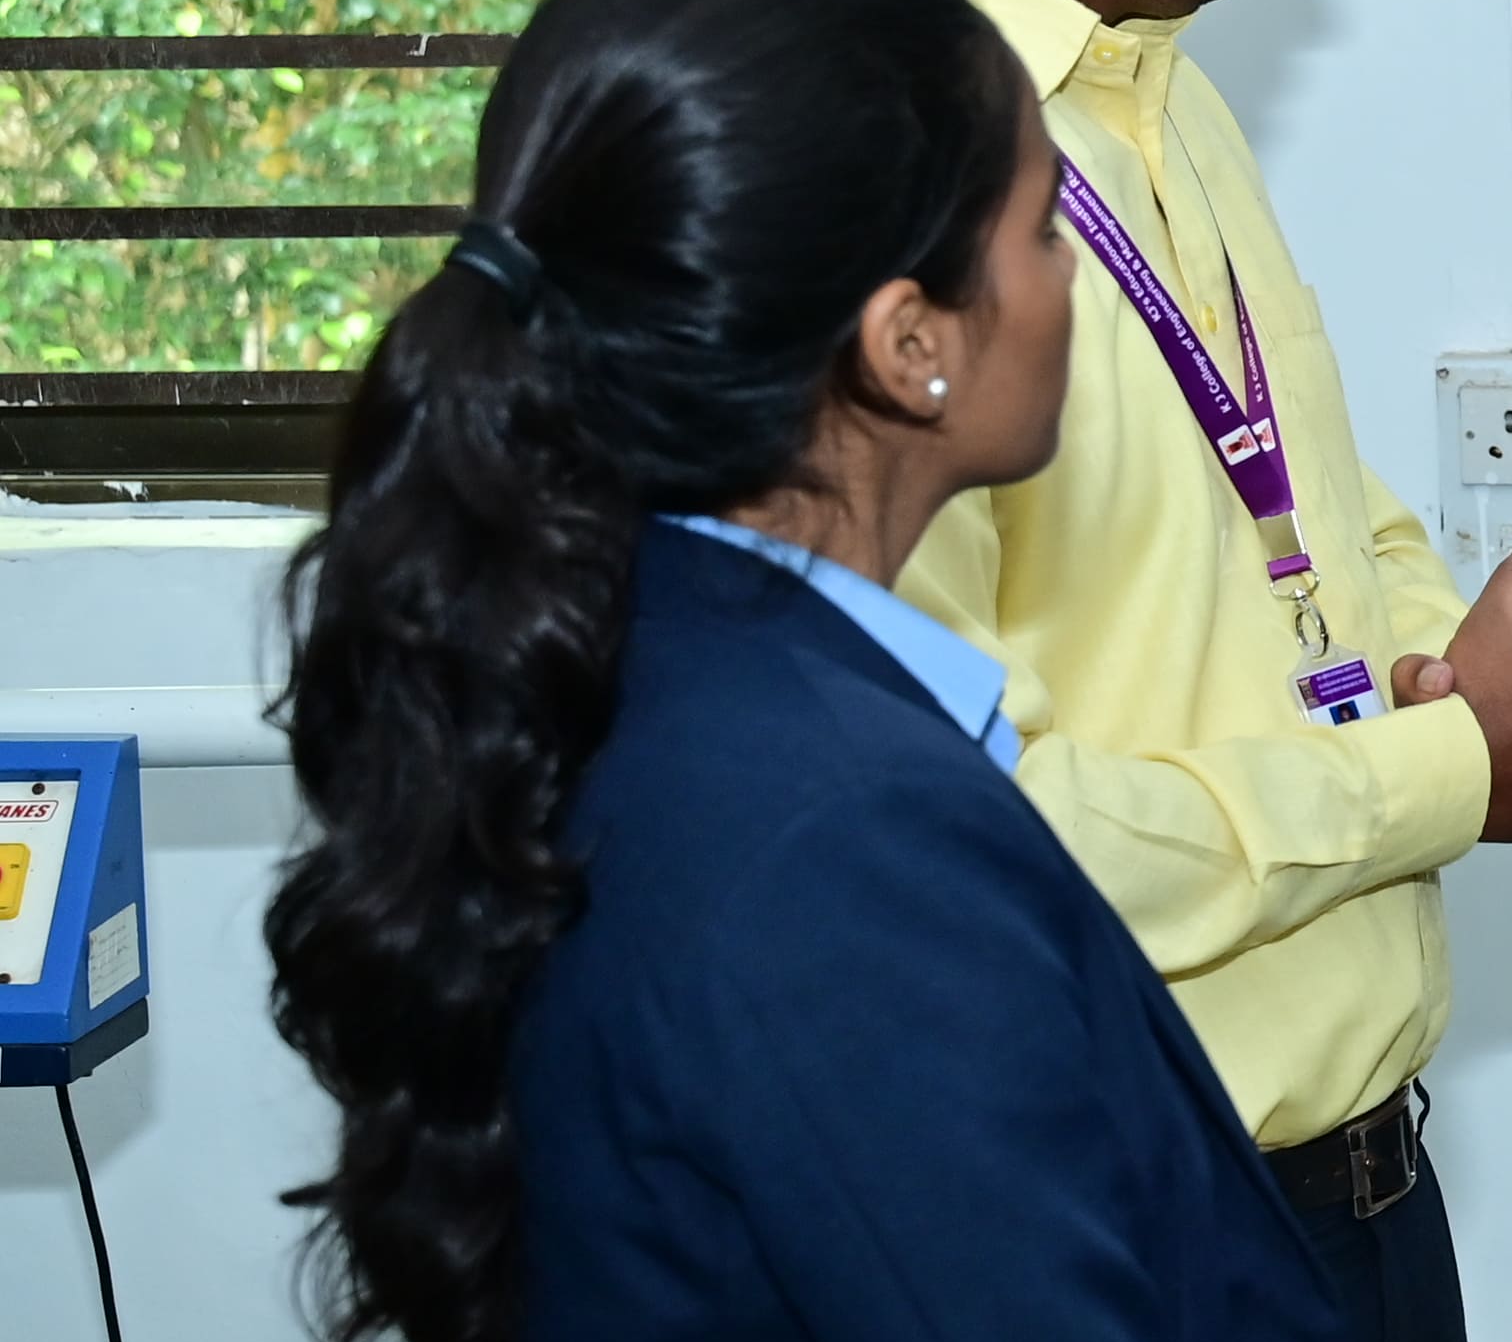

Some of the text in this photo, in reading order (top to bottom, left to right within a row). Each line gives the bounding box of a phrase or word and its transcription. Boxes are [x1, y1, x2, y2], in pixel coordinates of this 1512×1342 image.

[1075, 184, 1137, 261] Management
[1093, 229, 1147, 299] Educational
[1136, 266, 1190, 339] Engineering
[1179, 334, 1197, 352] of
[1188, 347, 1223, 395] College
[0, 804, 50, 818] ANES
